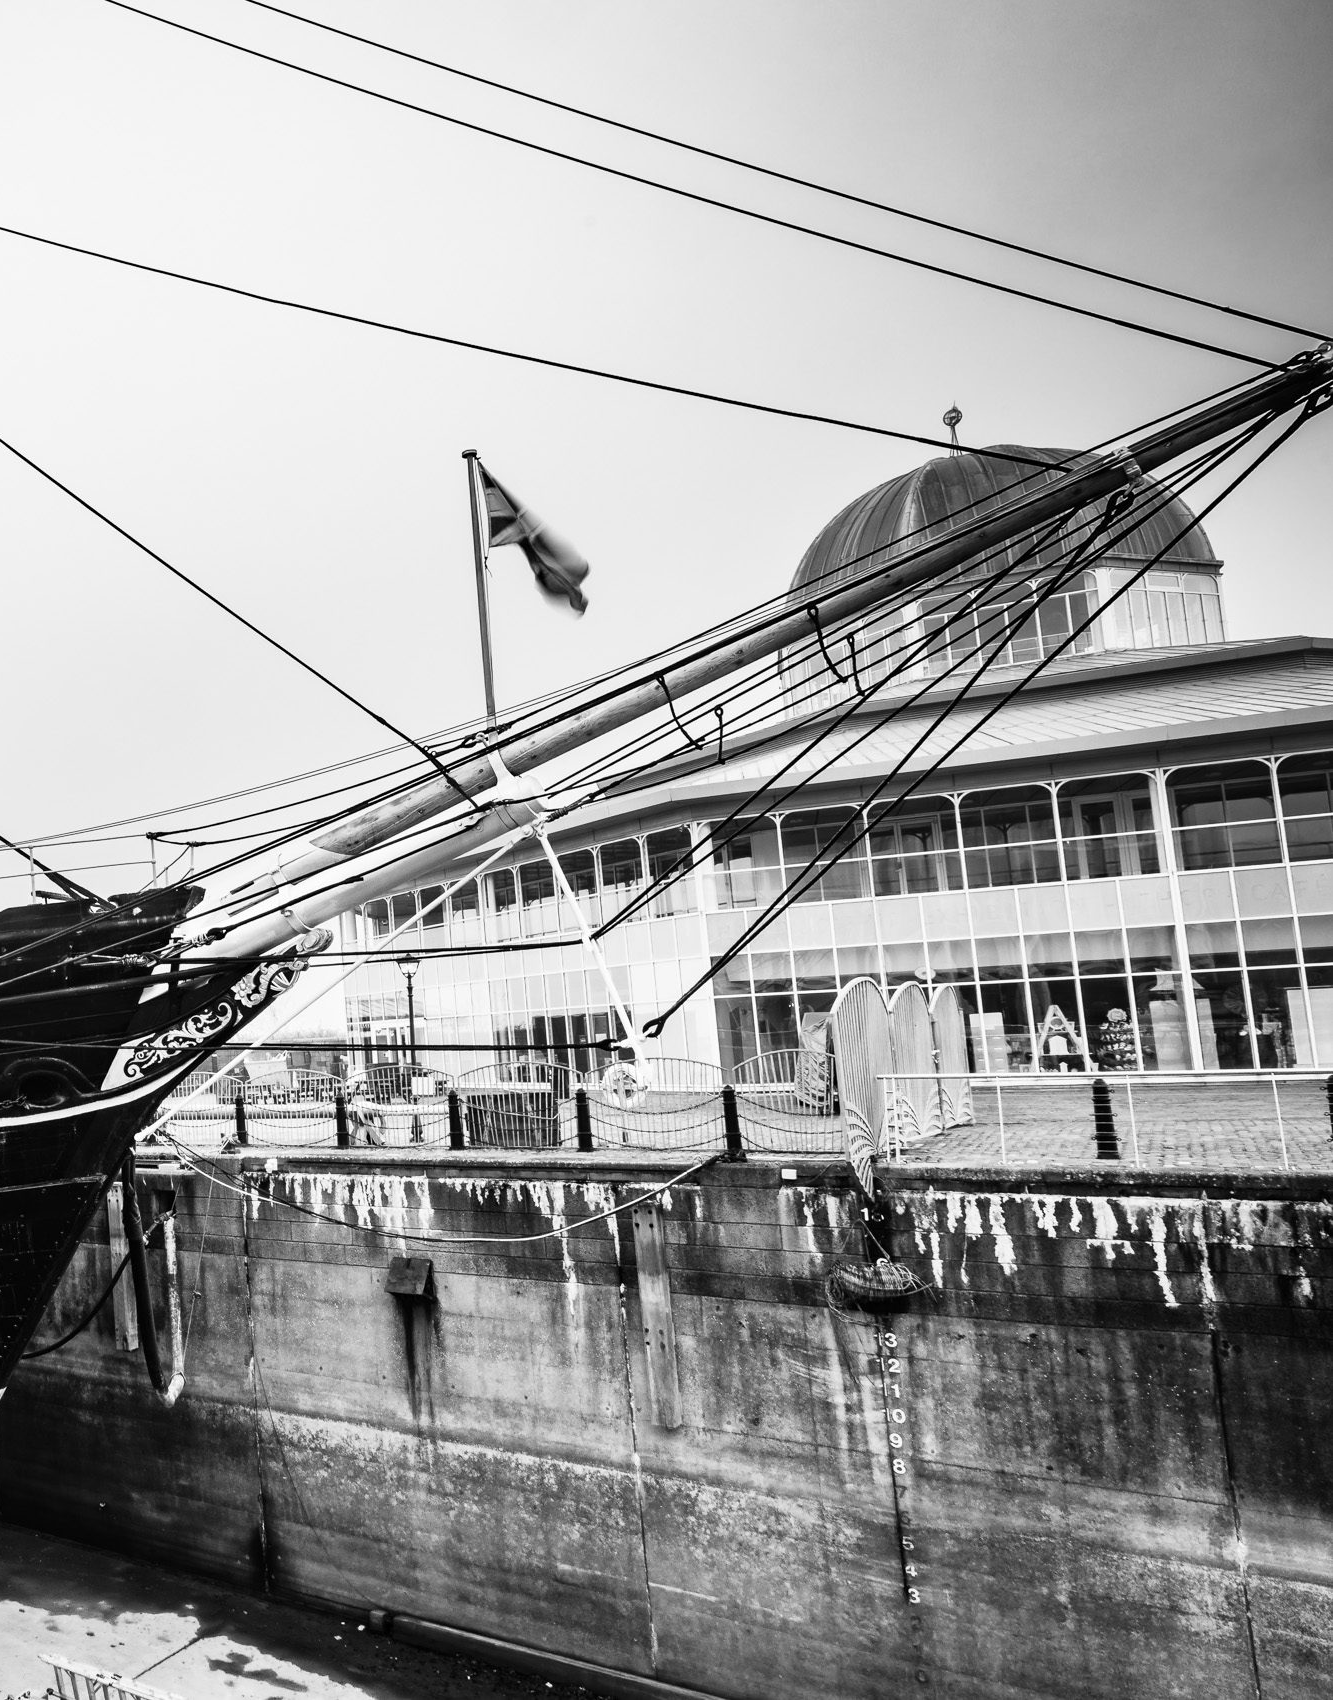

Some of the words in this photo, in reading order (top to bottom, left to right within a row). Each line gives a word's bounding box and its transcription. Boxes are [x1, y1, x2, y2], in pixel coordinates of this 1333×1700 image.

[874, 1332, 898, 1348] 13
[876, 1358, 901, 1374] 12
[889, 1432, 903, 1449] 9
[892, 1458, 907, 1475] 8
[895, 1485, 908, 1499] 7
[901, 1536, 915, 1551] 5
[905, 1565, 918, 1578] 4
[908, 1588, 921, 1604] 3
